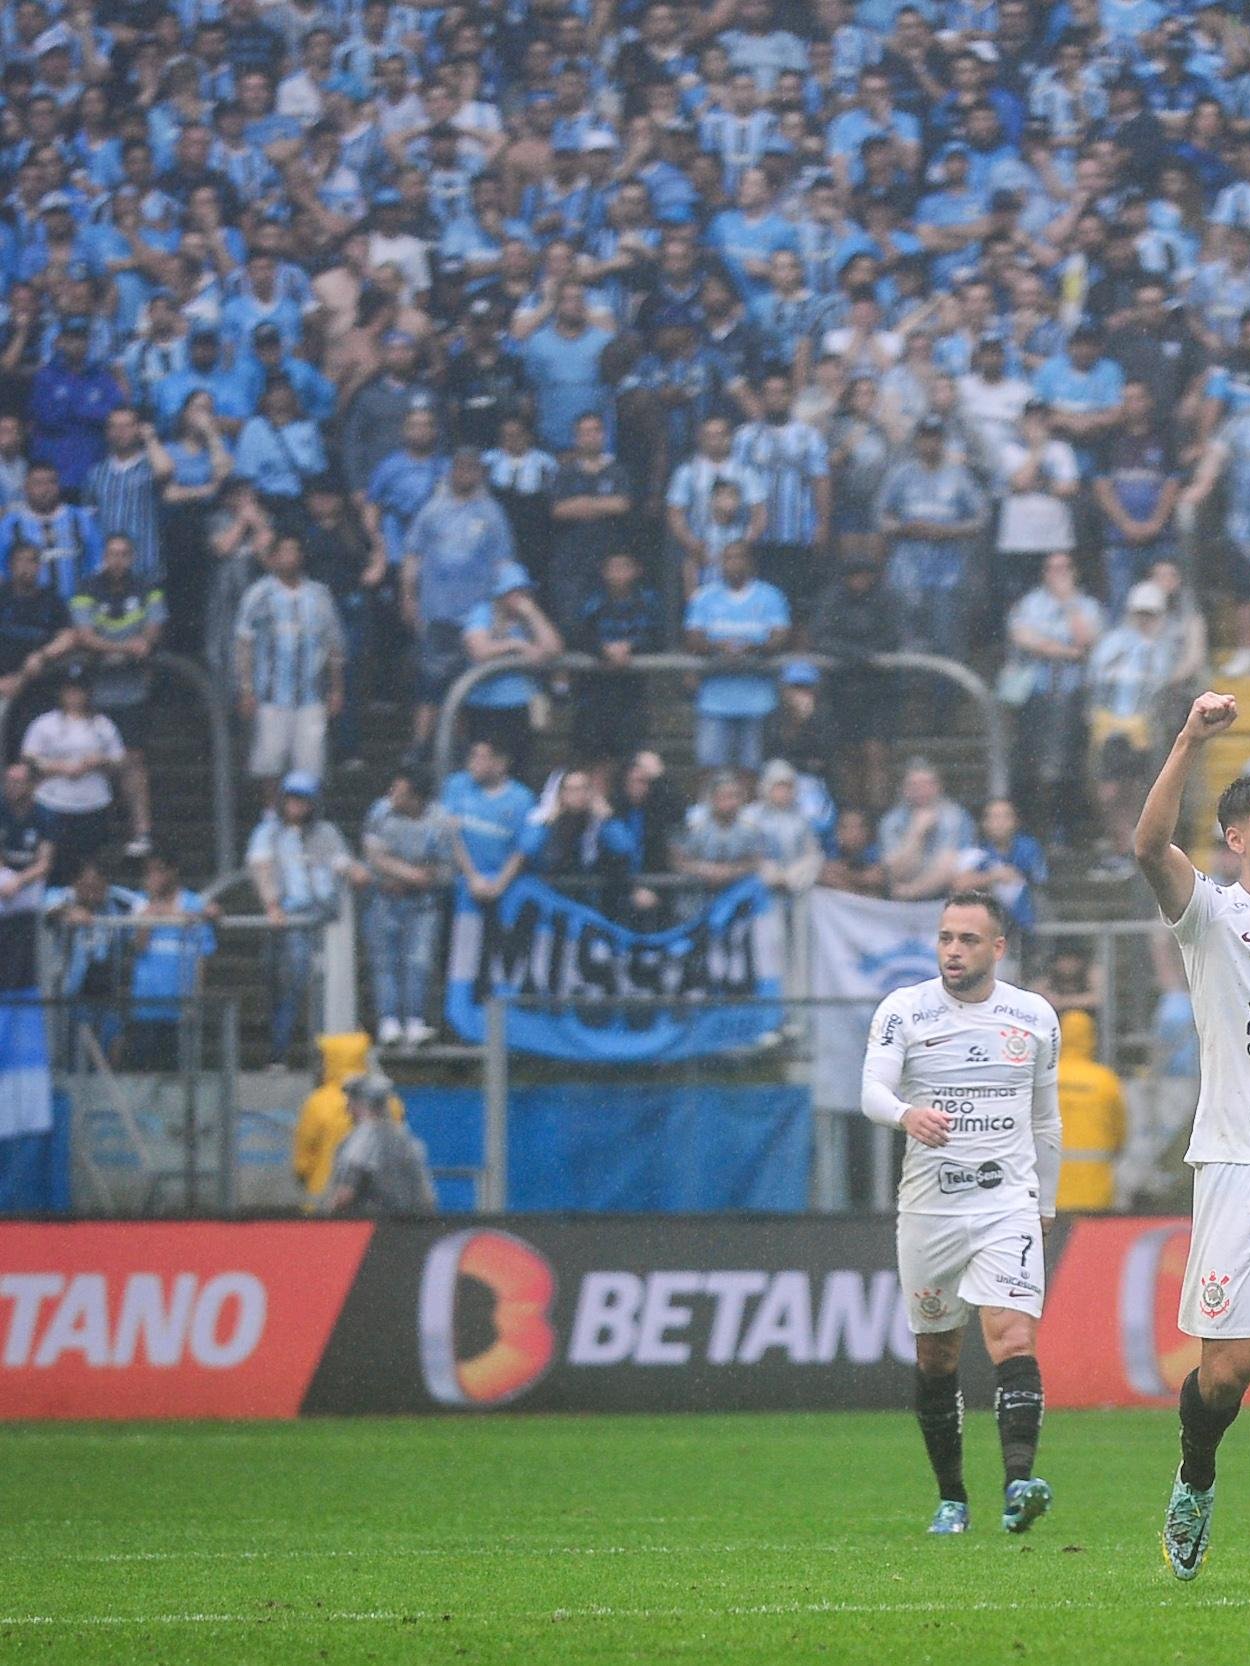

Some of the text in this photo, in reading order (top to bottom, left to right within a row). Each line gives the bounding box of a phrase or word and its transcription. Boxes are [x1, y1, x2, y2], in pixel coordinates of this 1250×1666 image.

[932, 1087, 1017, 1098] vitaminas
[932, 1099, 975, 1114] neo
[949, 1114, 1015, 1132] uímica
[944, 1172, 974, 1184] Tele
[1020, 1234, 1033, 1267] 7
[568, 1271, 917, 1364] BETAN
